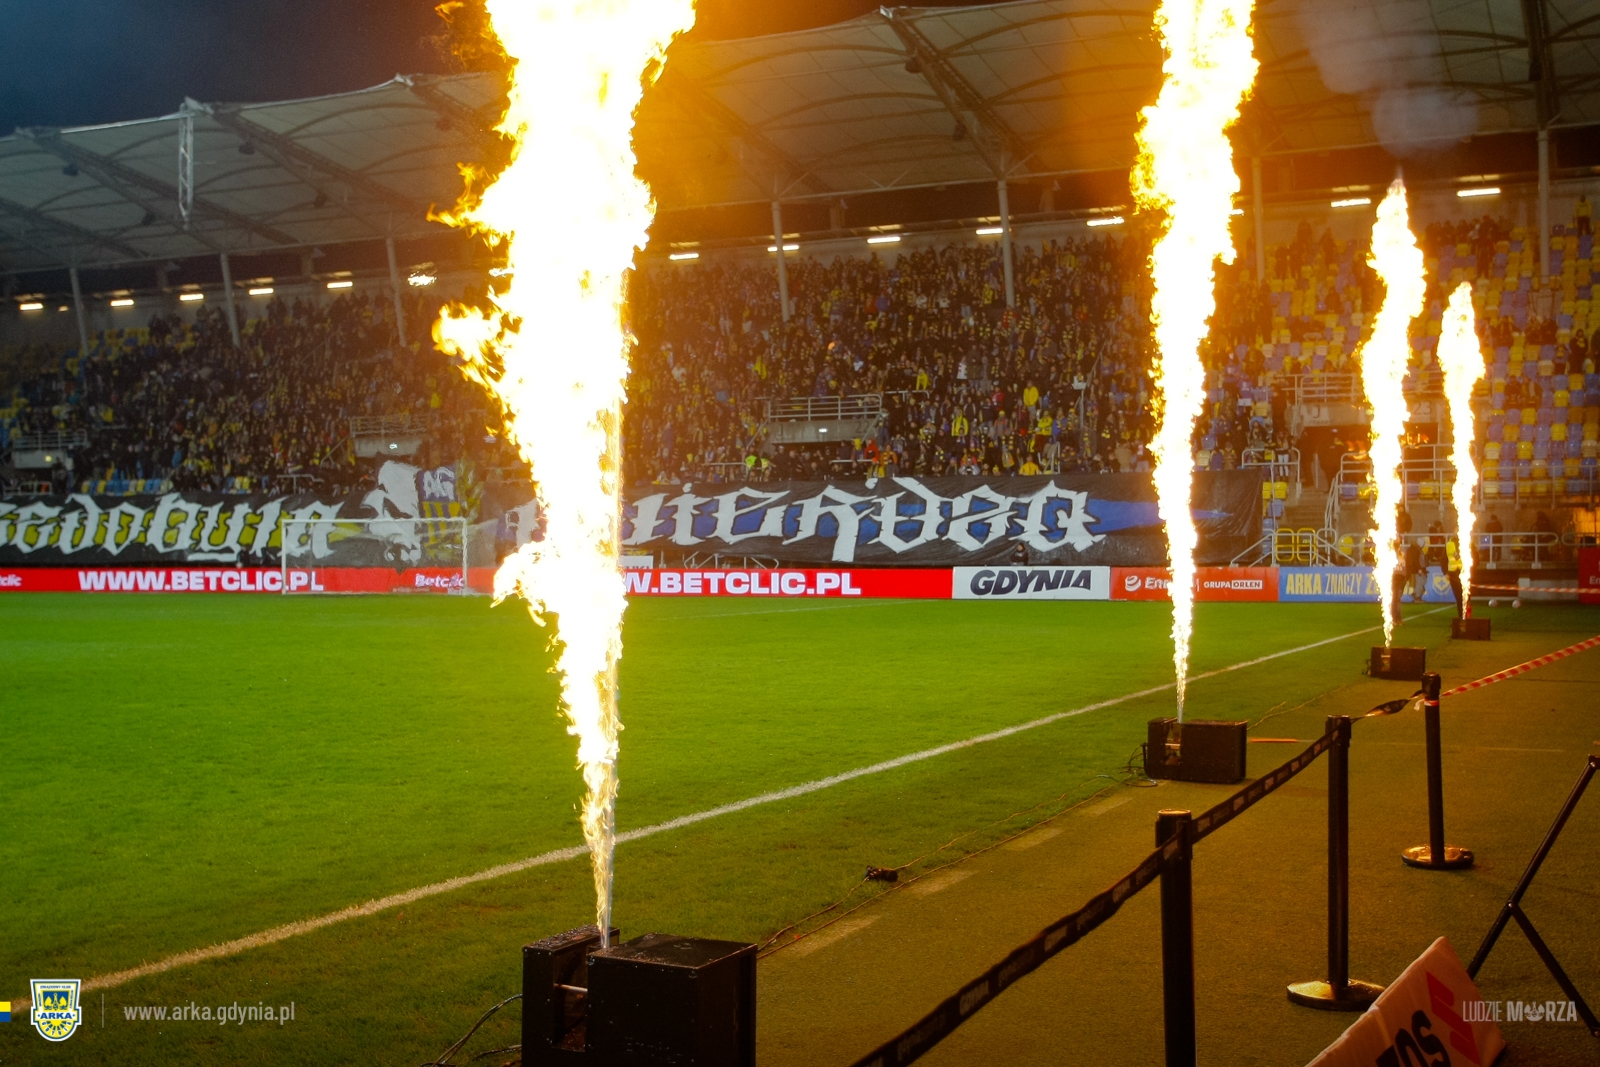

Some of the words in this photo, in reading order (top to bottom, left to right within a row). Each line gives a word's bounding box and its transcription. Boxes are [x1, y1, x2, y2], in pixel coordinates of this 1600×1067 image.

[78, 570, 324, 592] WWW.BETCLIC.PL
[625, 571, 861, 595] W.BETCLIC.PL
[970, 569, 1092, 596] GDYNIA
[1203, 581, 1231, 589] GRUPA
[1232, 581, 1261, 589] ORLEN
[1285, 573, 1322, 595] ARKA
[1325, 573, 1362, 595] ZNACZY
